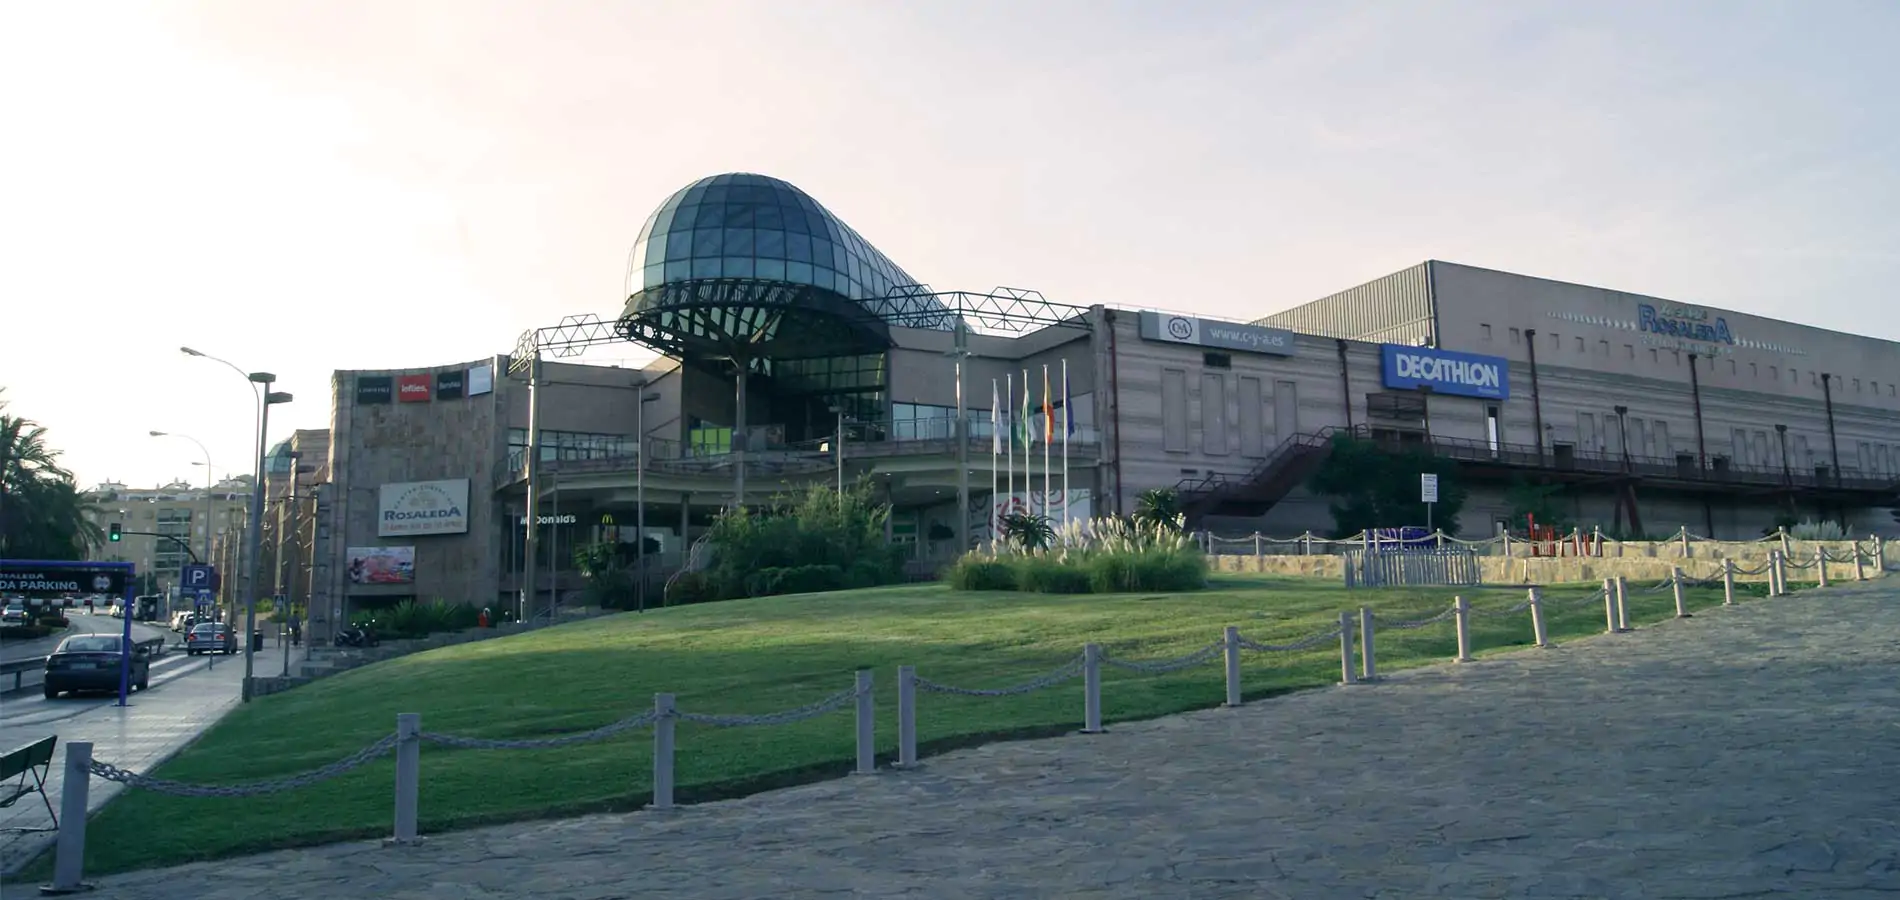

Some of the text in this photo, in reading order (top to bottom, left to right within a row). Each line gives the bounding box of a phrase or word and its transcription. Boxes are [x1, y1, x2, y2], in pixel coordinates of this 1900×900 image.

[1638, 303, 1733, 346] ROSALEDA
[1209, 327, 1284, 347] www.c-y-a.es
[1396, 353, 1500, 388] DECATHLON
[384, 506, 462, 521] ROSALEDA
[192, 570, 206, 584] P
[20, 581, 78, 591] PARKING
